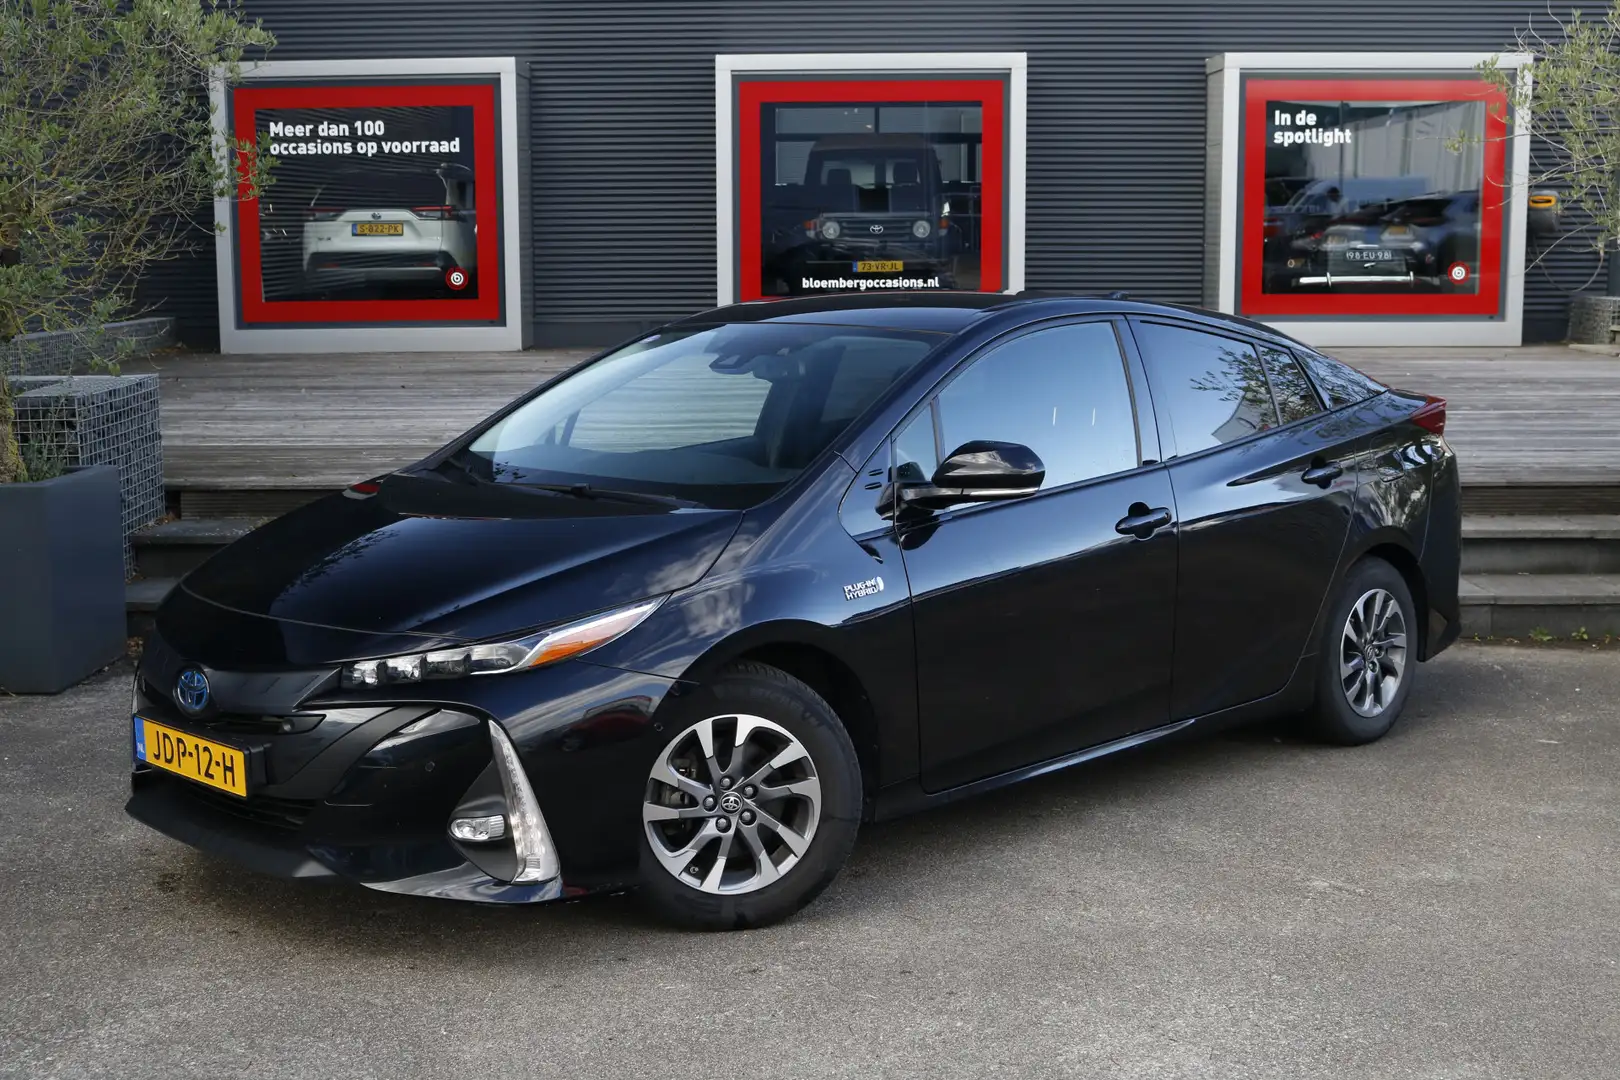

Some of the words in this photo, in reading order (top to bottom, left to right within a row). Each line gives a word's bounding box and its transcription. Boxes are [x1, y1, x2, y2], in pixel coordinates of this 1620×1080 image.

[1274, 110, 1291, 126] In
[1295, 110, 1317, 126] de
[269, 122, 314, 137] Meer
[318, 121, 349, 136] dan
[354, 120, 385, 136] 100
[1273, 128, 1352, 147] spotlight
[269, 139, 353, 155] occasions
[356, 141, 378, 157] op
[381, 137, 460, 153] voorraad
[802, 277, 940, 291] bloembergoccasions.nl
[845, 587, 879, 600] HYBRID
[153, 730, 235, 787] JDP-12-H
